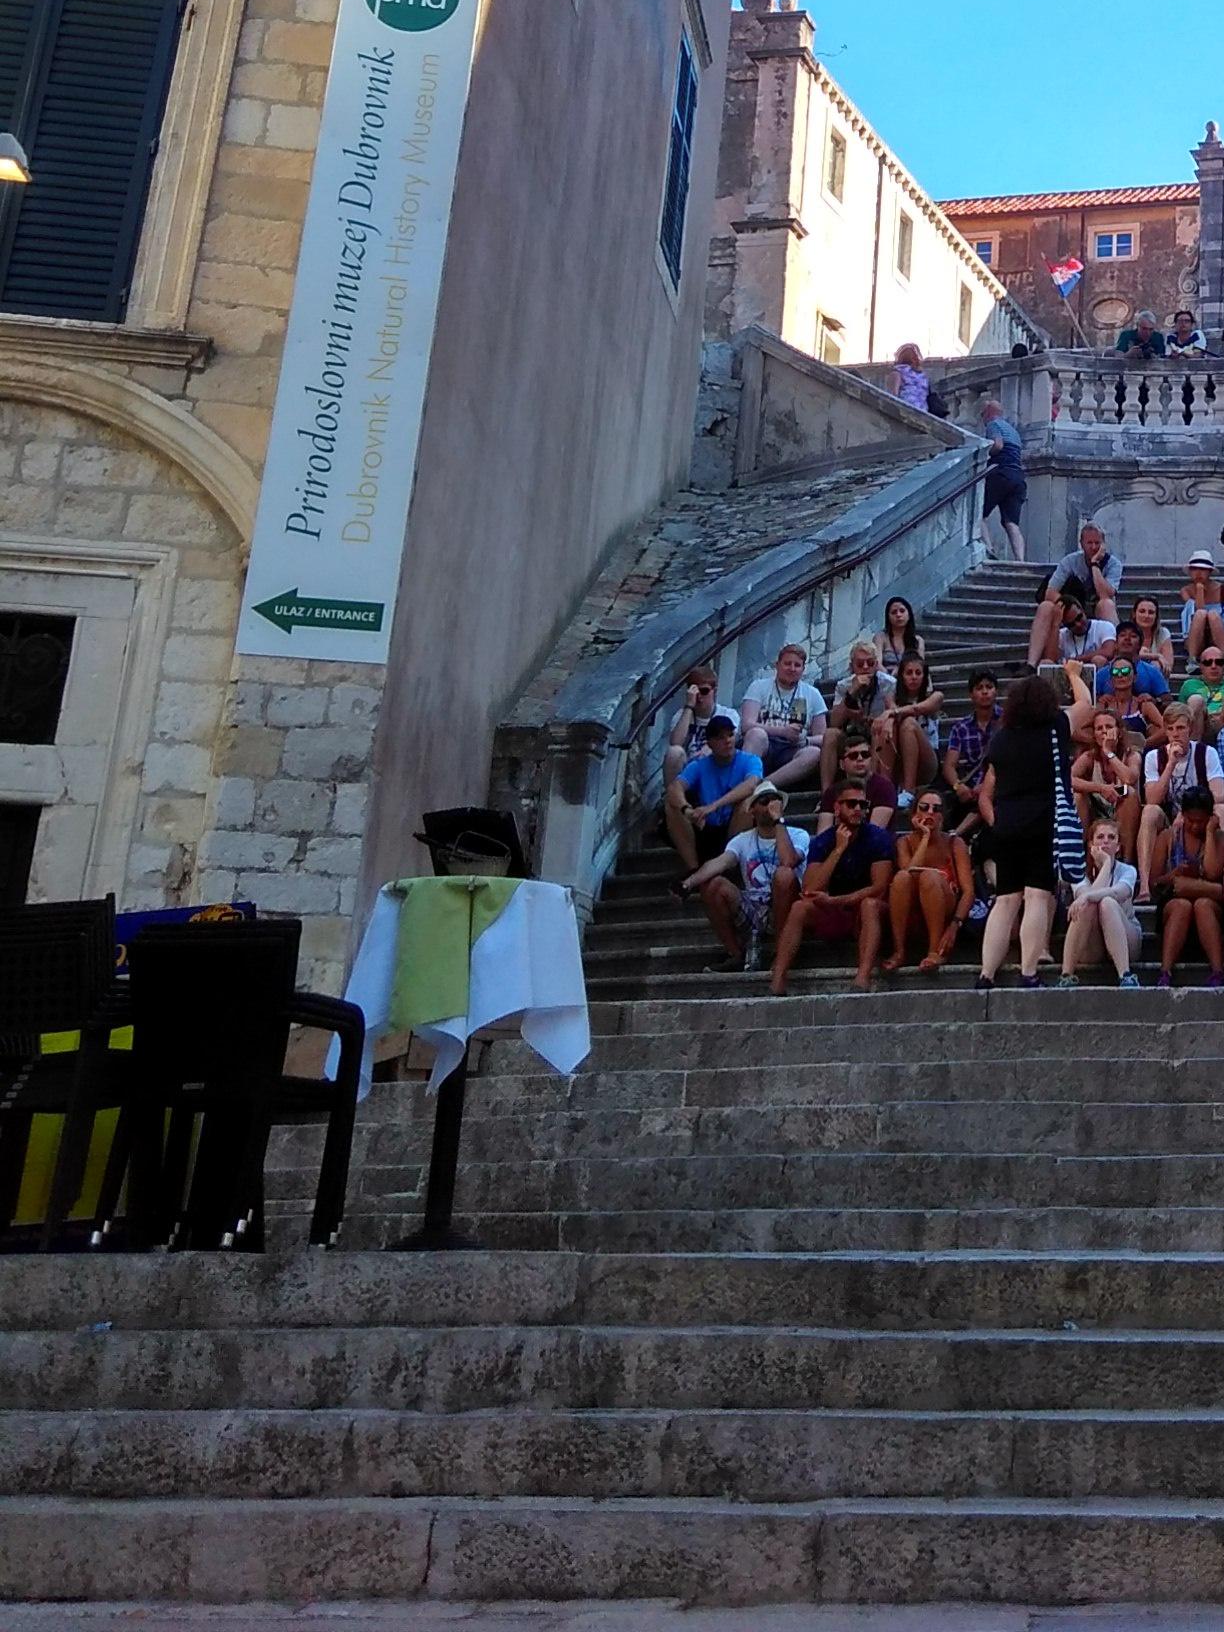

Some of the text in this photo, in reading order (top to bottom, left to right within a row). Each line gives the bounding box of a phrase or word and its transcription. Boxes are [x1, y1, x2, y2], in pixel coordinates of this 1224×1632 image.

[284, 46, 395, 542] Prirodoslovni muzej Dubrovnik
[341, 54, 440, 543] Dubrovnik Natural History Museum
[274, 605, 305, 617] ULAZ
[314, 608, 376, 622] ENTRANCE
